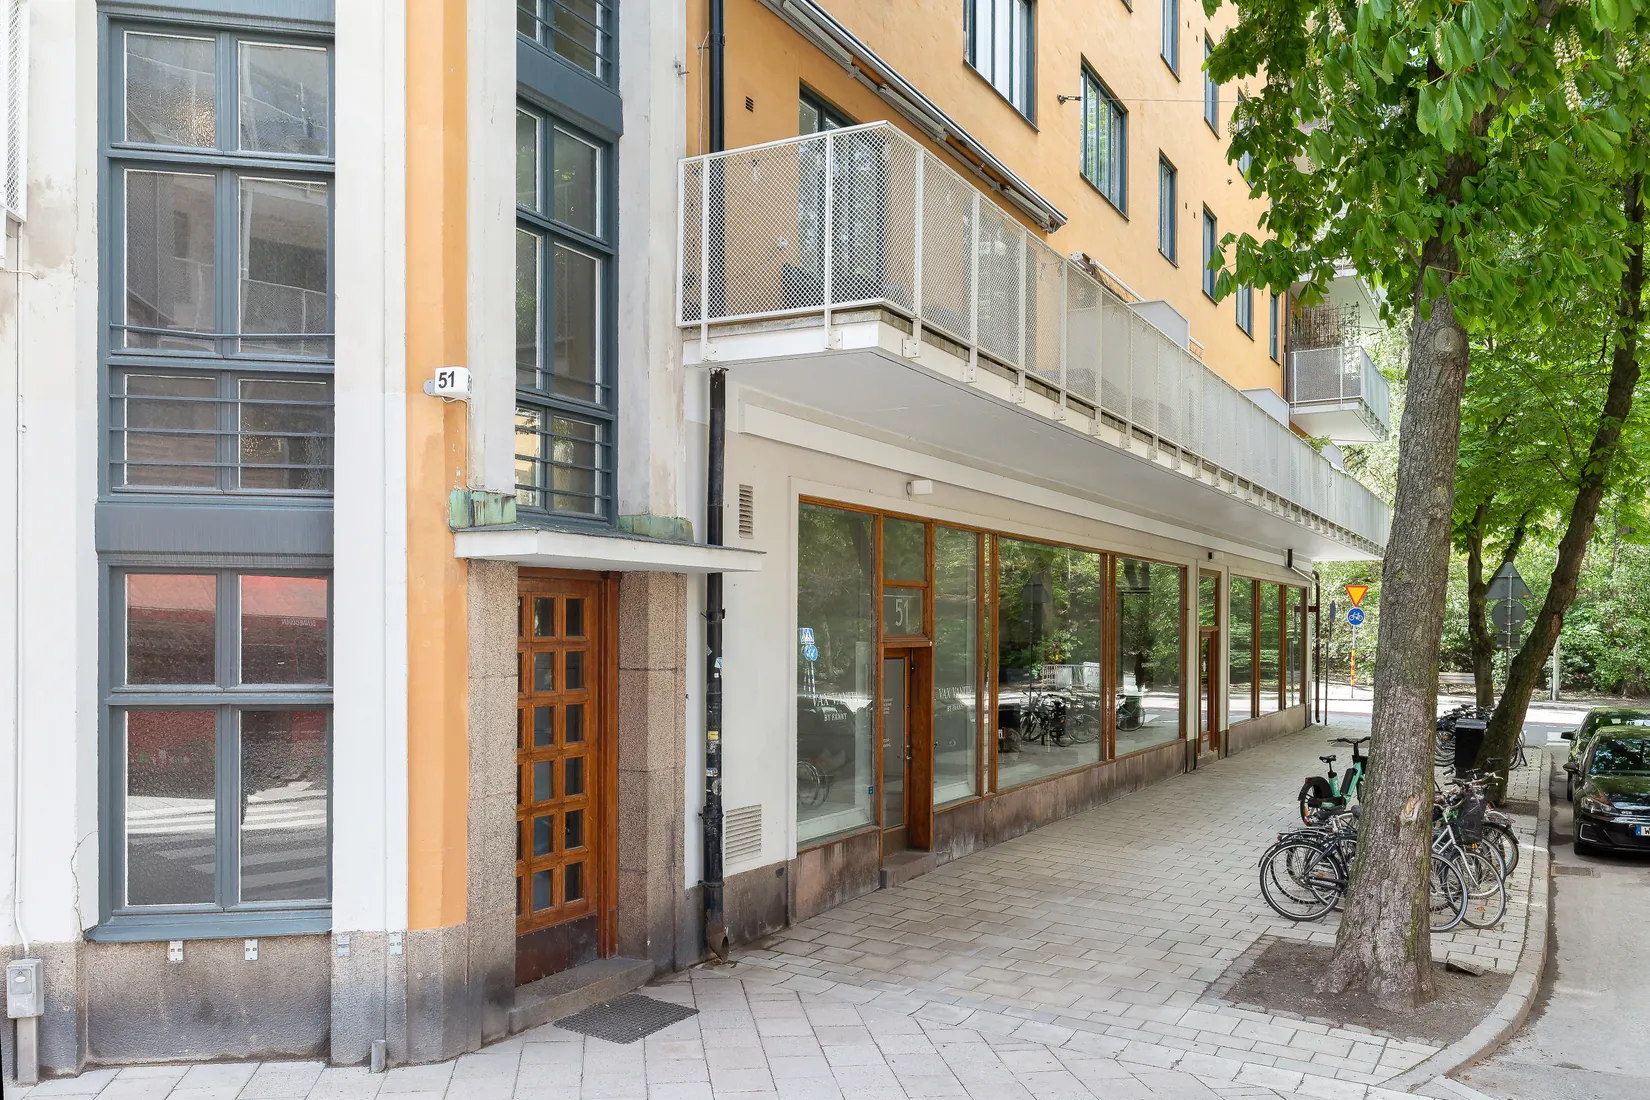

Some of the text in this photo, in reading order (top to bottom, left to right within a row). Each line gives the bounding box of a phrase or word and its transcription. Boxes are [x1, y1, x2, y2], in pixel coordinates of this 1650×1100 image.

[438, 371, 455, 389] 51
[895, 598, 909, 627] 51
[938, 687, 951, 700] VAX
[824, 714, 831, 722] BY
